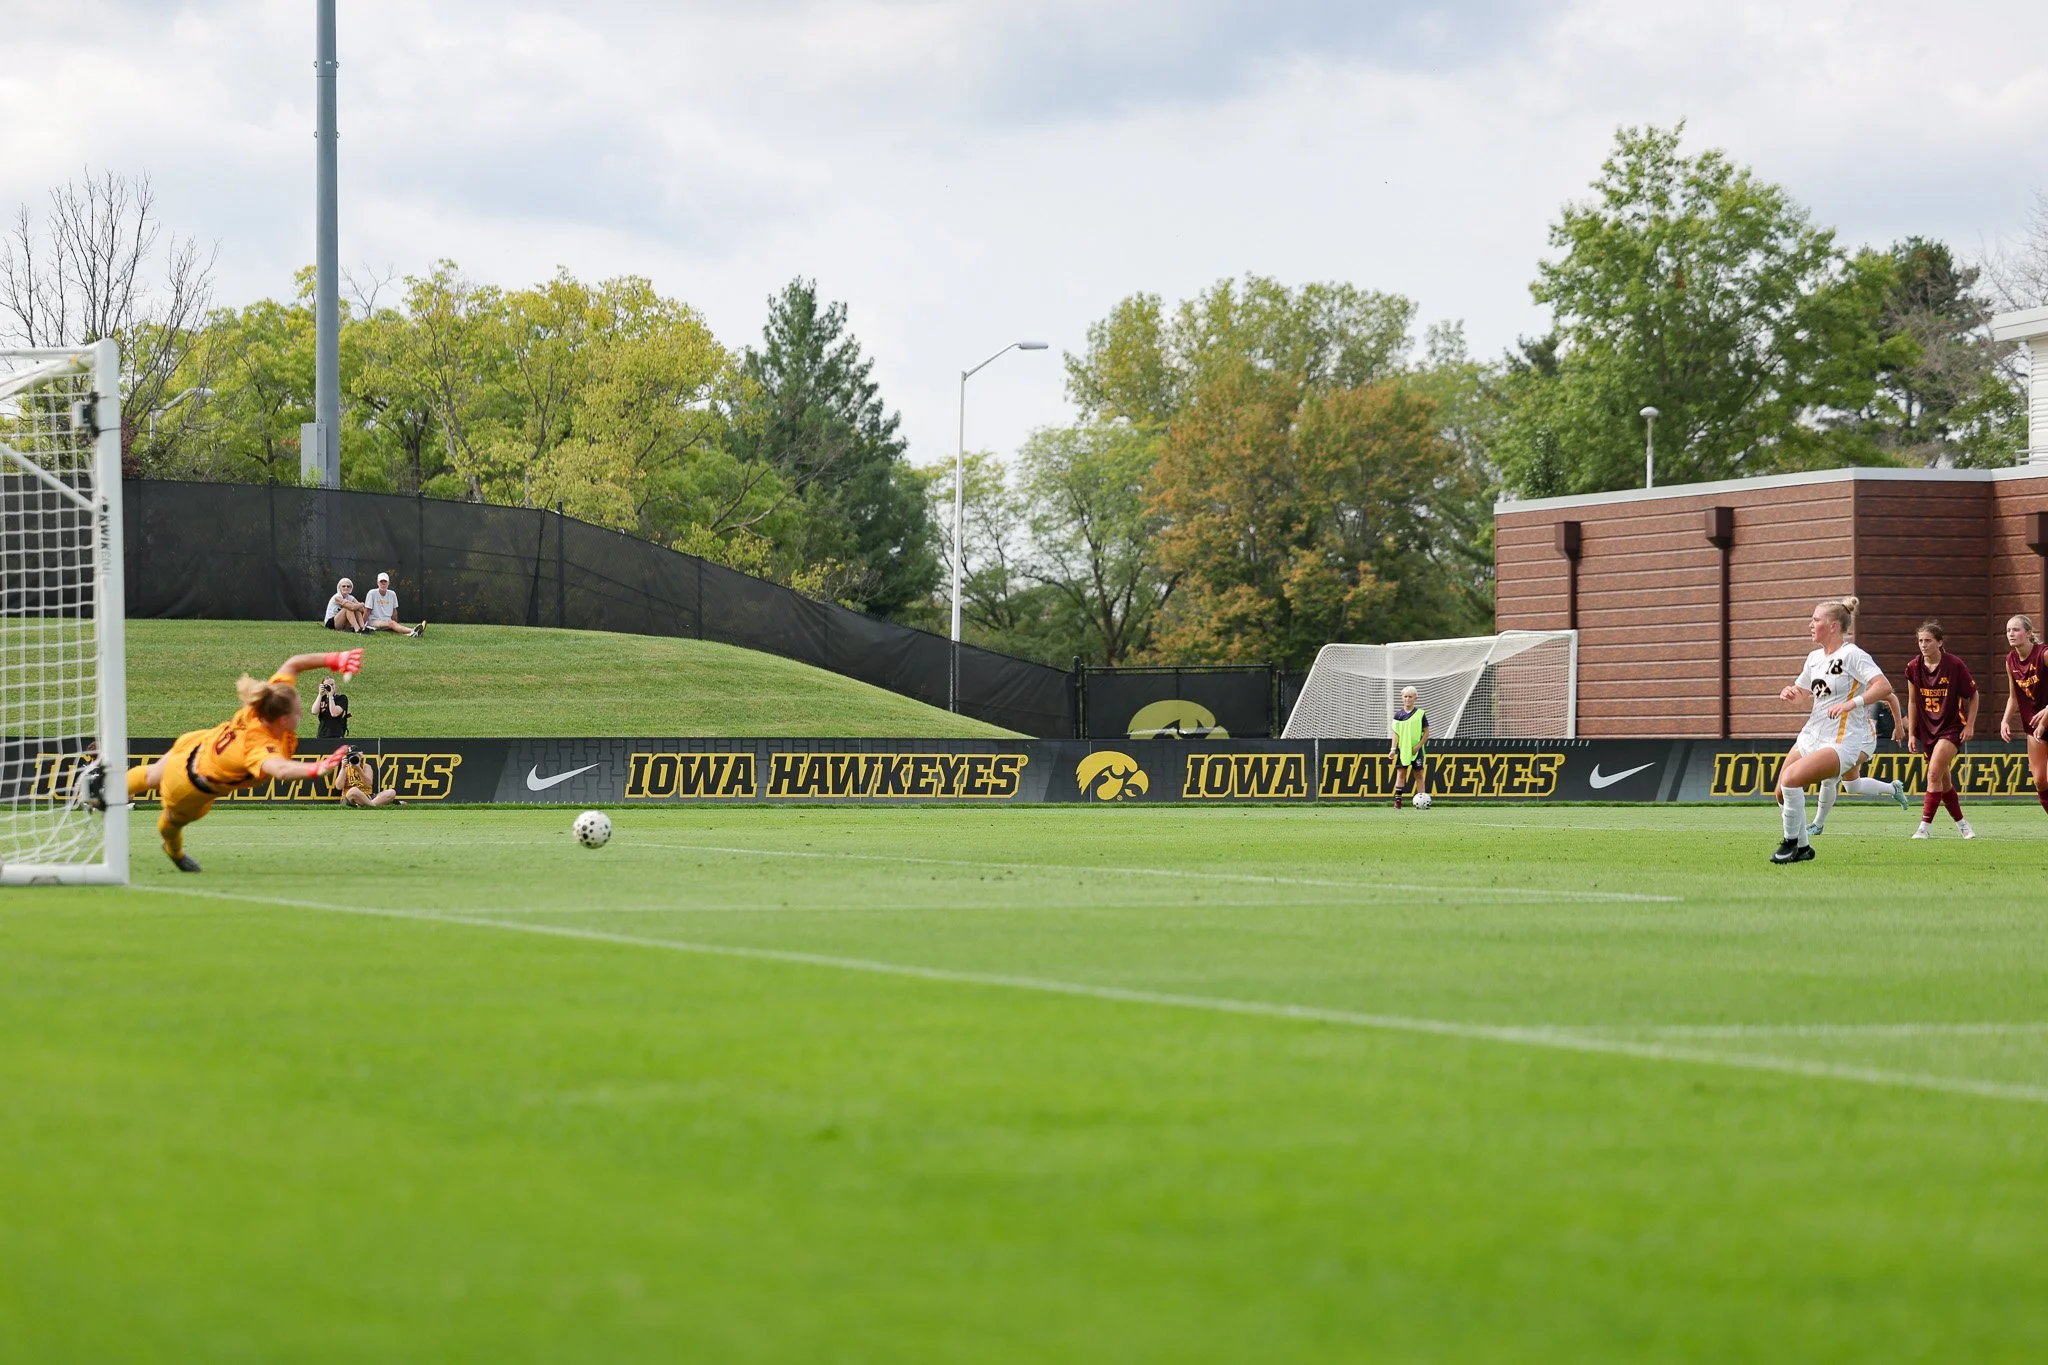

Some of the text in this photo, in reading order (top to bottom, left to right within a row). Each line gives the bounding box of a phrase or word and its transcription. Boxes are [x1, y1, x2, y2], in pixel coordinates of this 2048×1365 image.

[1825, 658, 1843, 675] 18
[1924, 697, 1940, 713] 25
[624, 752, 1022, 798] IOWA HAWKEYES
[1182, 753, 1308, 798] IOWA
